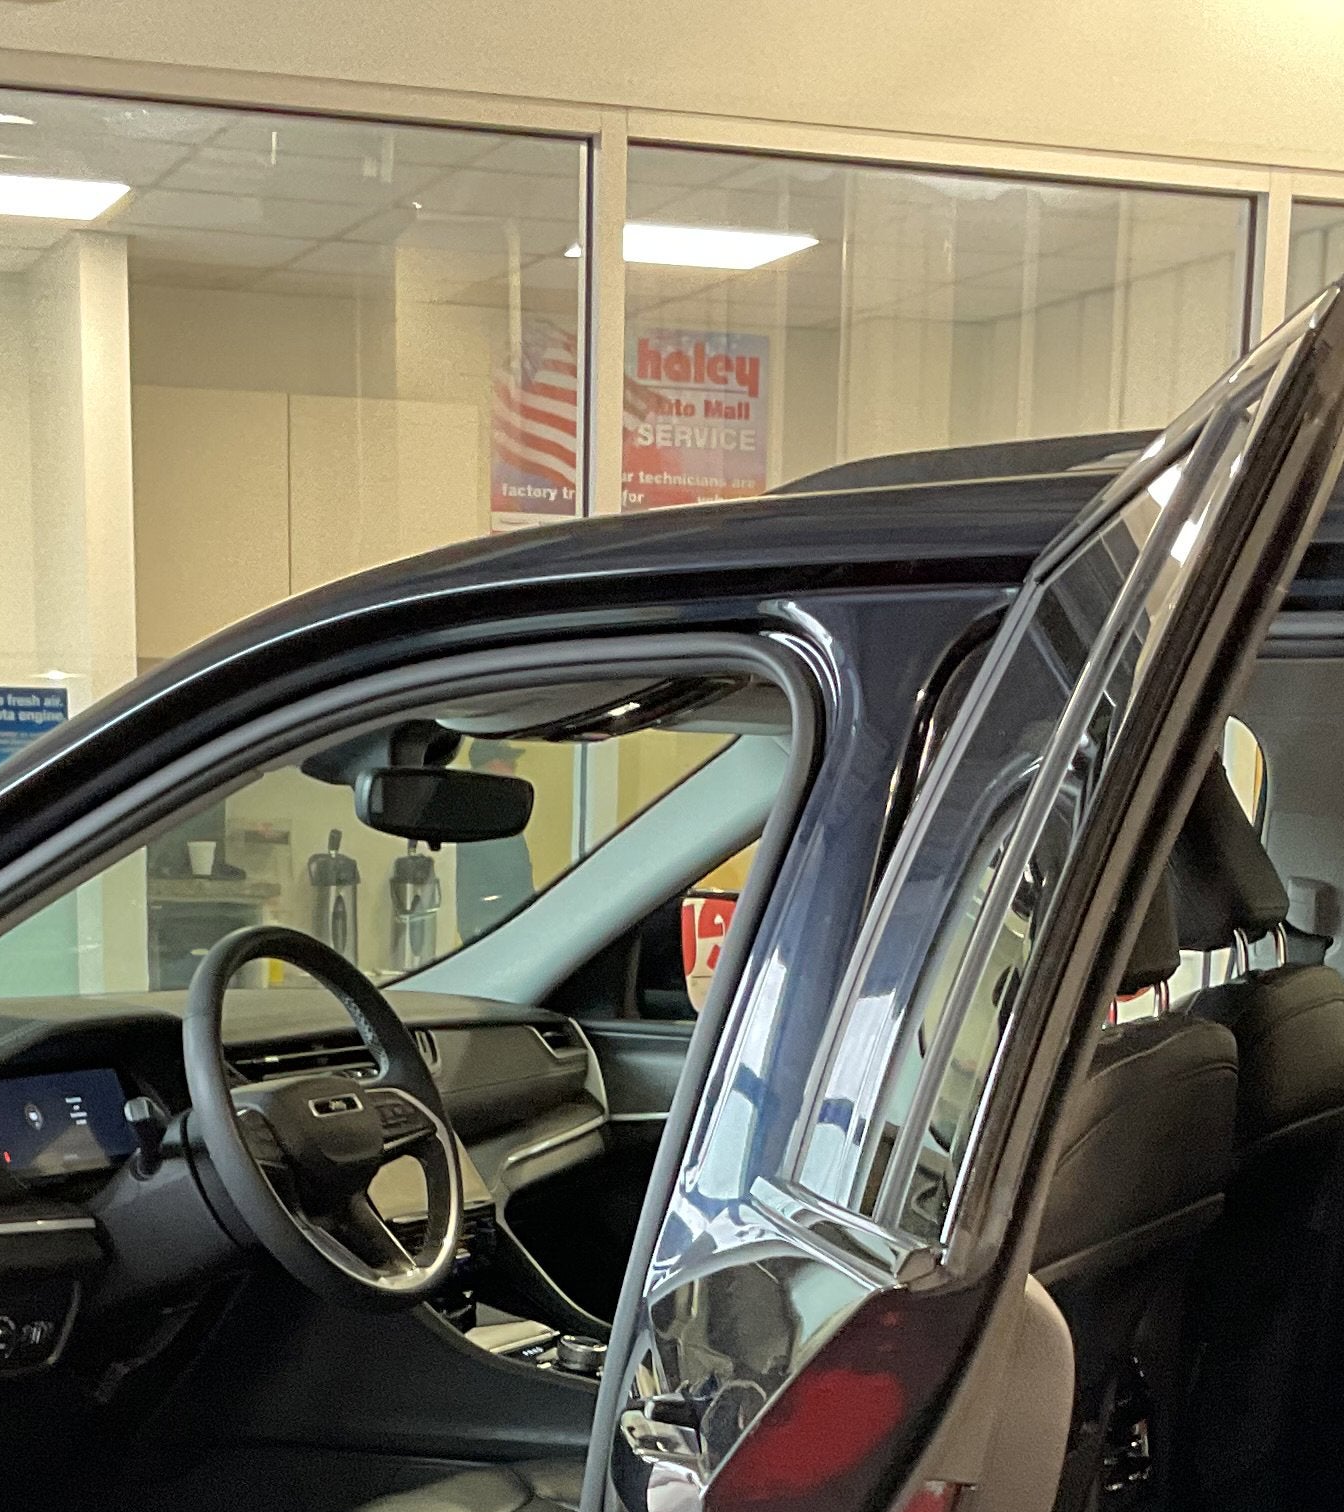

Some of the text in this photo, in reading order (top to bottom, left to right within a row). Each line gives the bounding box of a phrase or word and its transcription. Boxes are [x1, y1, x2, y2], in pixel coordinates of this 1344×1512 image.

[637, 338, 760, 398] haley
[703, 400, 750, 420] Mall
[636, 424, 756, 451] SERVICE
[502, 483, 557, 501] factory
[7, 694, 41, 707] fresh
